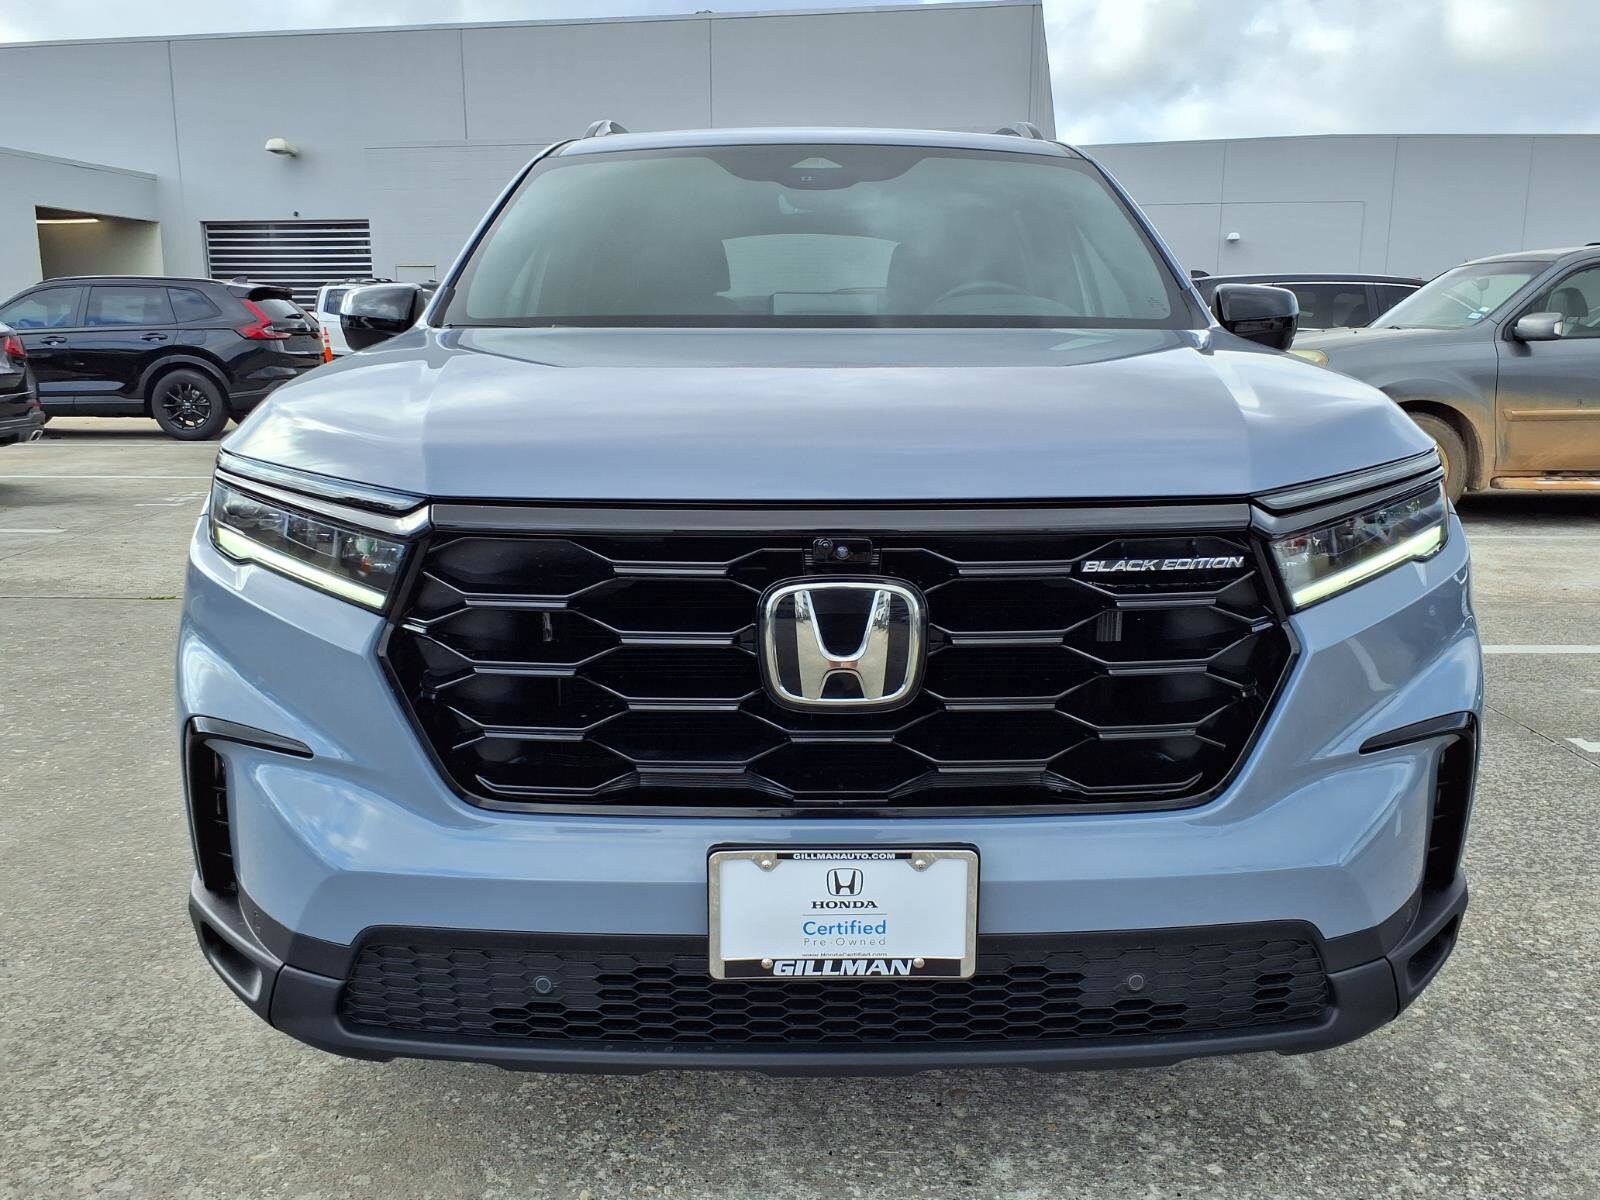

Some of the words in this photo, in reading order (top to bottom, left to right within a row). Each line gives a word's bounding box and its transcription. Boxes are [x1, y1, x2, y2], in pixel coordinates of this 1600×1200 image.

[1082, 559, 1156, 573] BLACK
[1161, 556, 1244, 571] EDITION
[793, 852, 896, 860] GILLMANAUTO.COM
[811, 900, 879, 909] HONDA
[802, 919, 887, 936] Certified
[803, 937, 886, 946] Pre-Owned
[772, 959, 913, 976] GILLMAN
